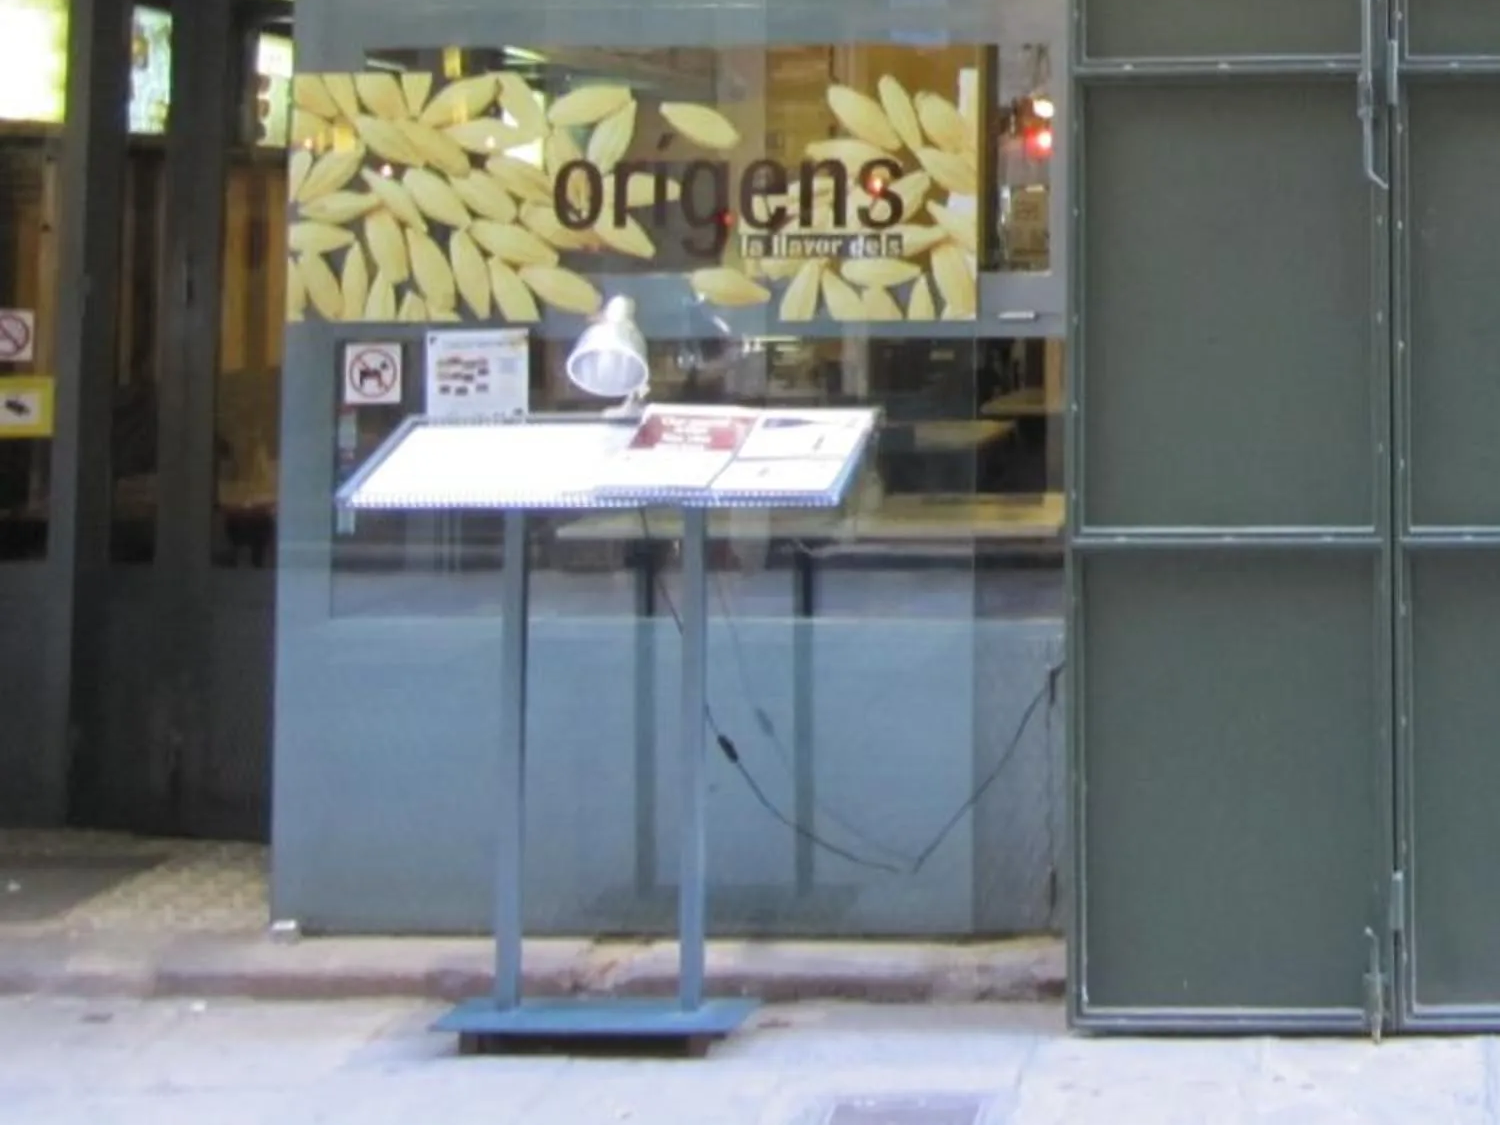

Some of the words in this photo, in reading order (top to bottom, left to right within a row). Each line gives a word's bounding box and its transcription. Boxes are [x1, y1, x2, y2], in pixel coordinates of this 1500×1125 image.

[740, 234, 764, 257] la
[772, 234, 842, 257] llavor
[849, 234, 901, 257] dels
